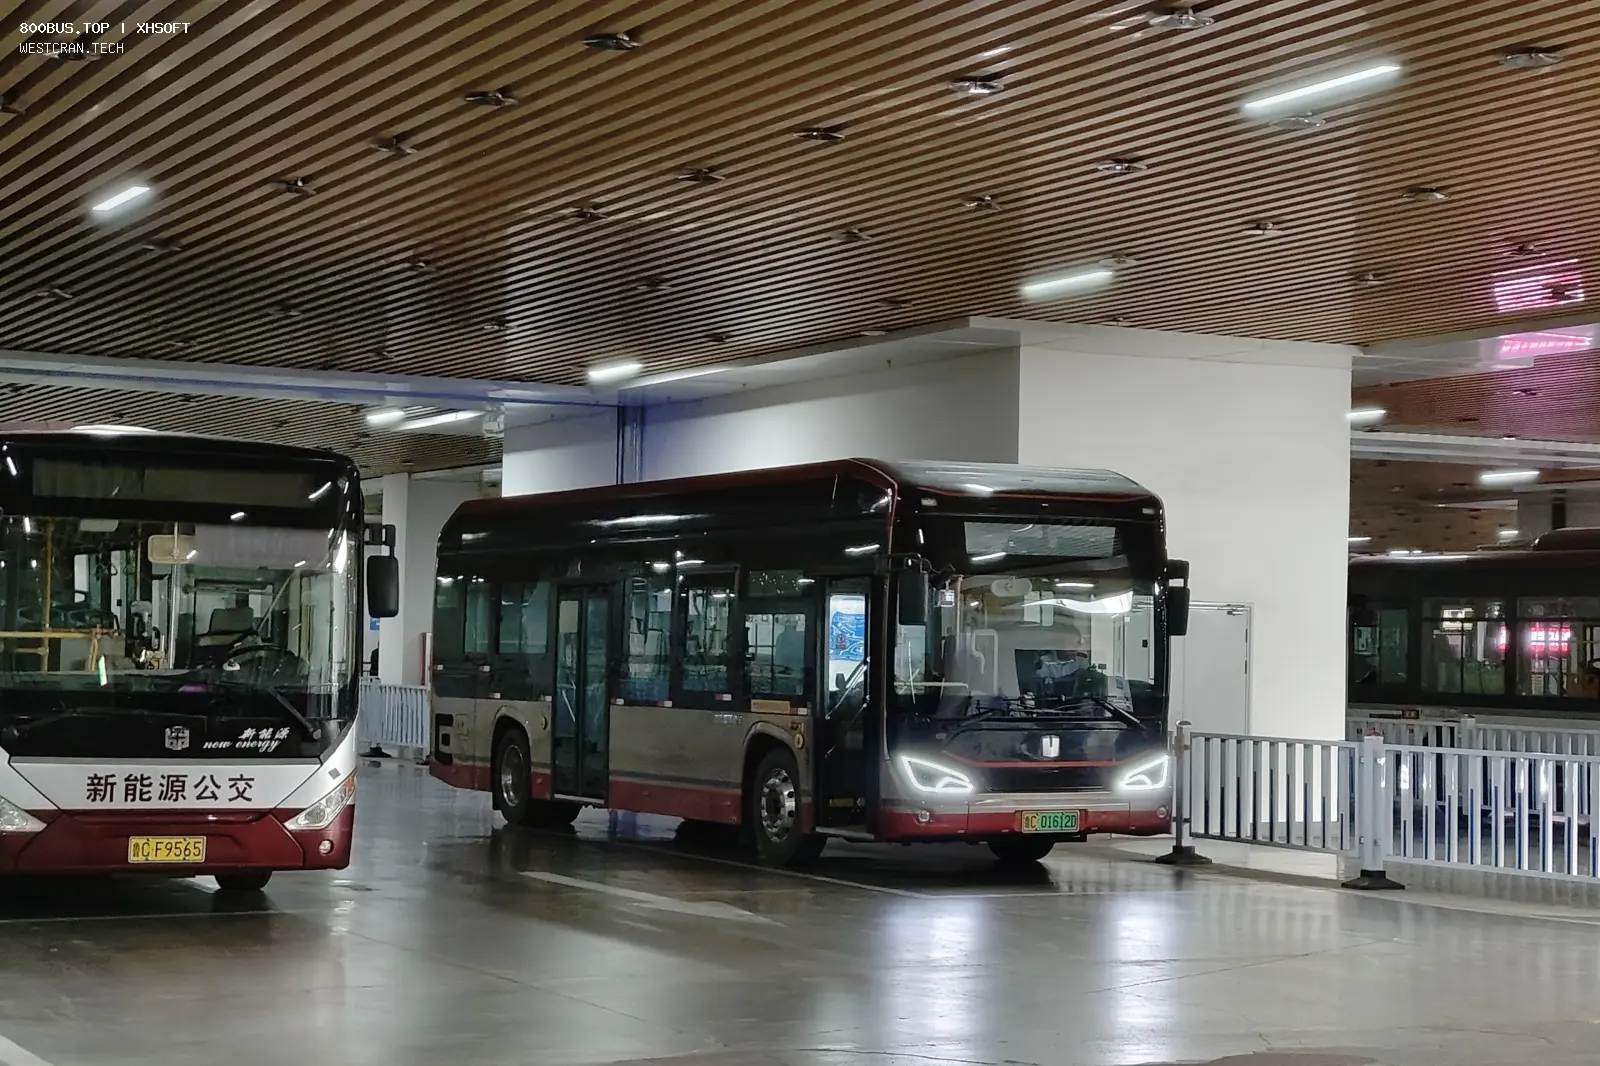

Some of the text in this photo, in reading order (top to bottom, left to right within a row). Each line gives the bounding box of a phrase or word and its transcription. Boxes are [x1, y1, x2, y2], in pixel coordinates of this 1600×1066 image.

[238, 727, 291, 741] 新能源
[235, 740, 282, 753] energy
[86, 773, 256, 803] 新能源公交
